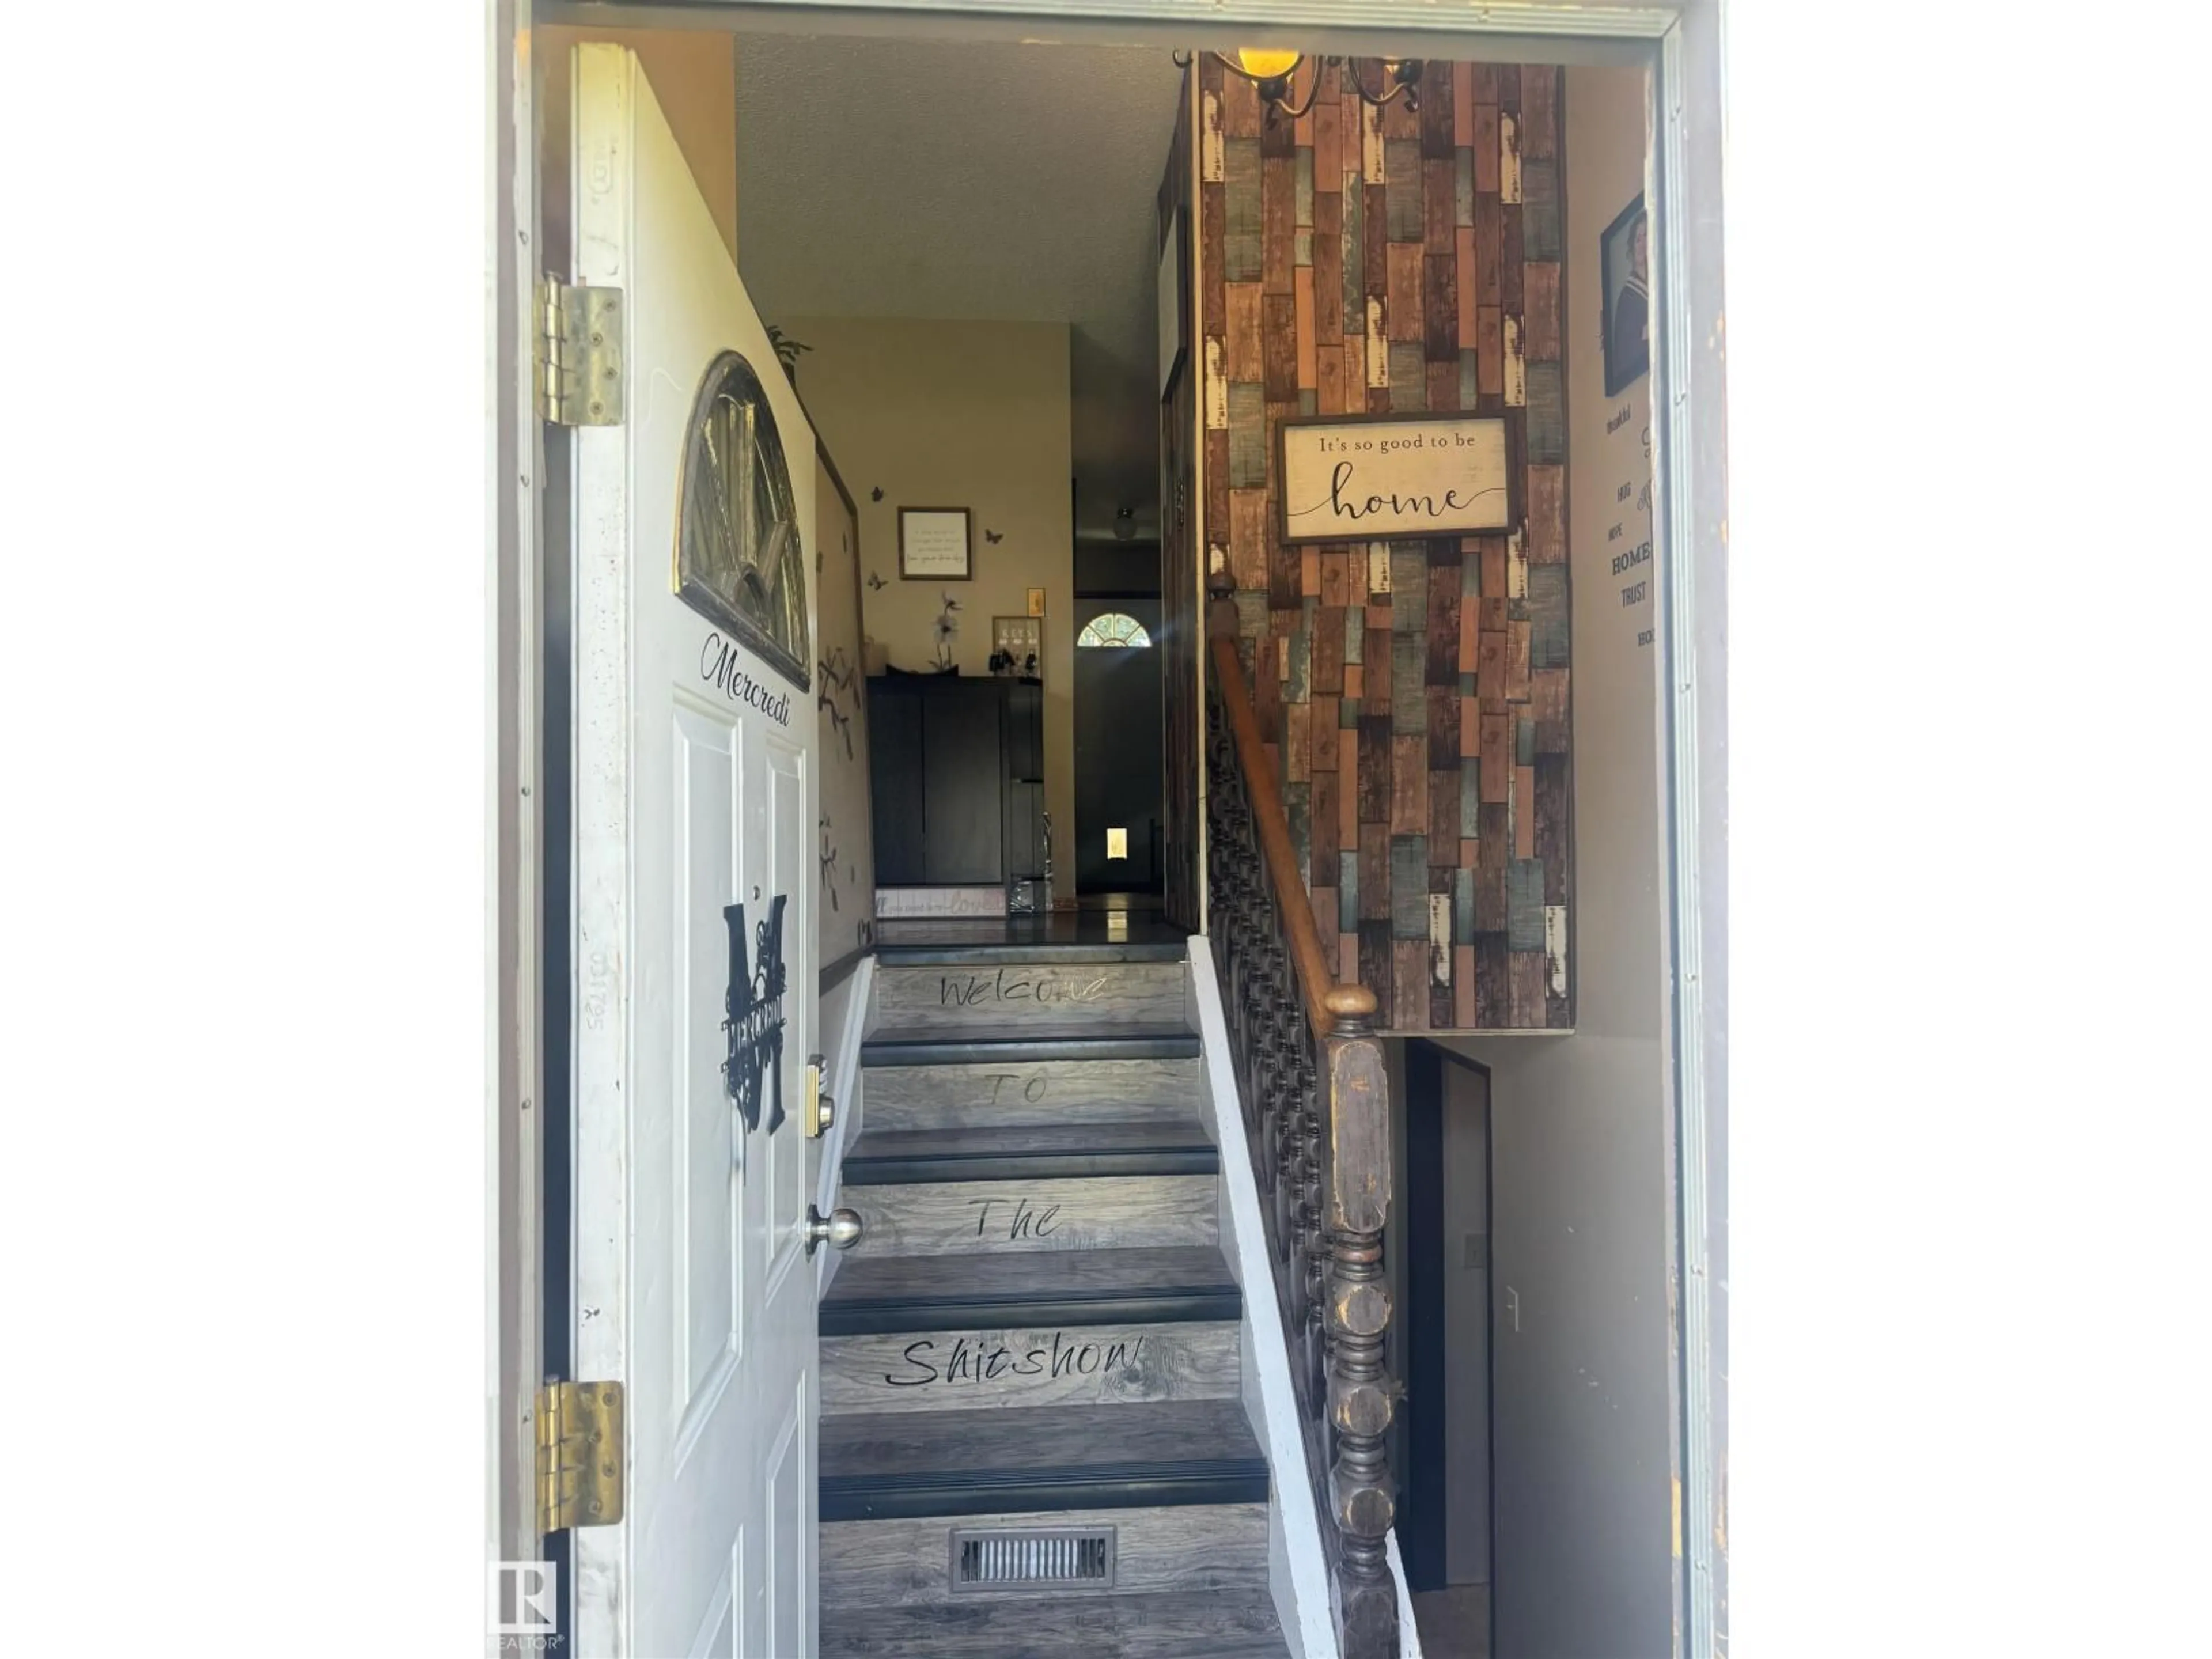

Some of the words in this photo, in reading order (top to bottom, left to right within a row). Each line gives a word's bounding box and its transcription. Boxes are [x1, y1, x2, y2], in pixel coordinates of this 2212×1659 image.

[1319, 436, 1347, 452] It's
[1354, 440, 1373, 450] so
[1380, 433, 1423, 454] good
[1431, 436, 1448, 448] to
[1455, 433, 1476, 447] be
[1287, 461, 1505, 520] home
[1611, 541, 1650, 576] HOME
[1620, 581, 1646, 609] TRUST
[701, 632, 790, 727] Mercredi
[969, 1198, 1063, 1240] The
[885, 1331, 1144, 1386] Shitshow
